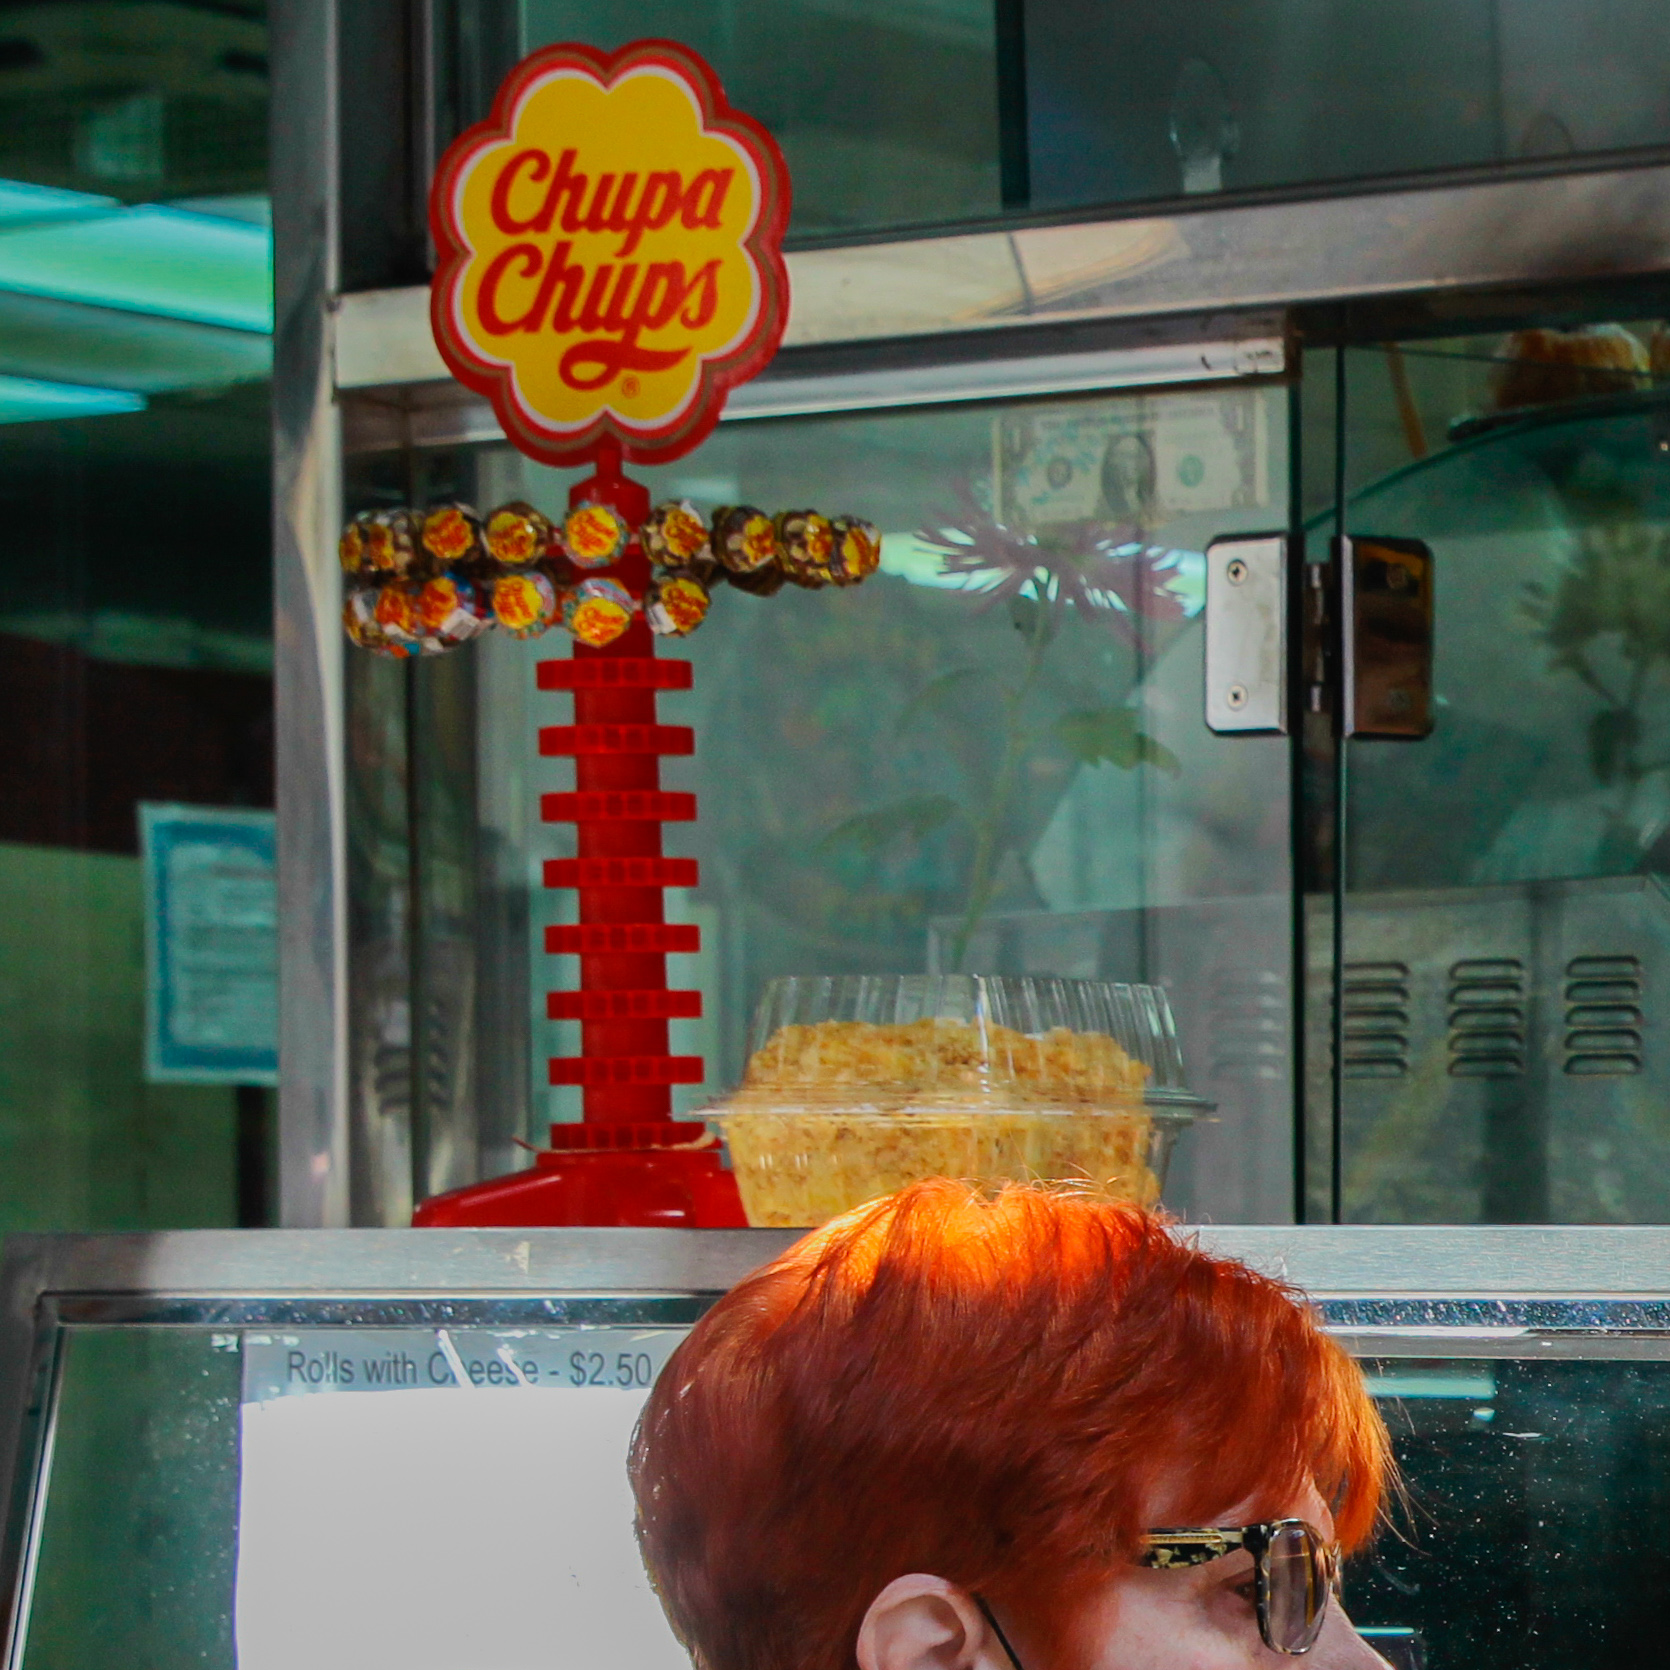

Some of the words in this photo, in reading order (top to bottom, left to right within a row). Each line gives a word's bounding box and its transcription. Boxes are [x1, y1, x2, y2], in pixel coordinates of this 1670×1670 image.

[491, 148, 735, 258] Chupa
[476, 240, 725, 392] Chups
[288, 1351, 354, 1384] Rolls
[363, 1351, 418, 1384] with
[569, 1352, 652, 1387] $2.50
